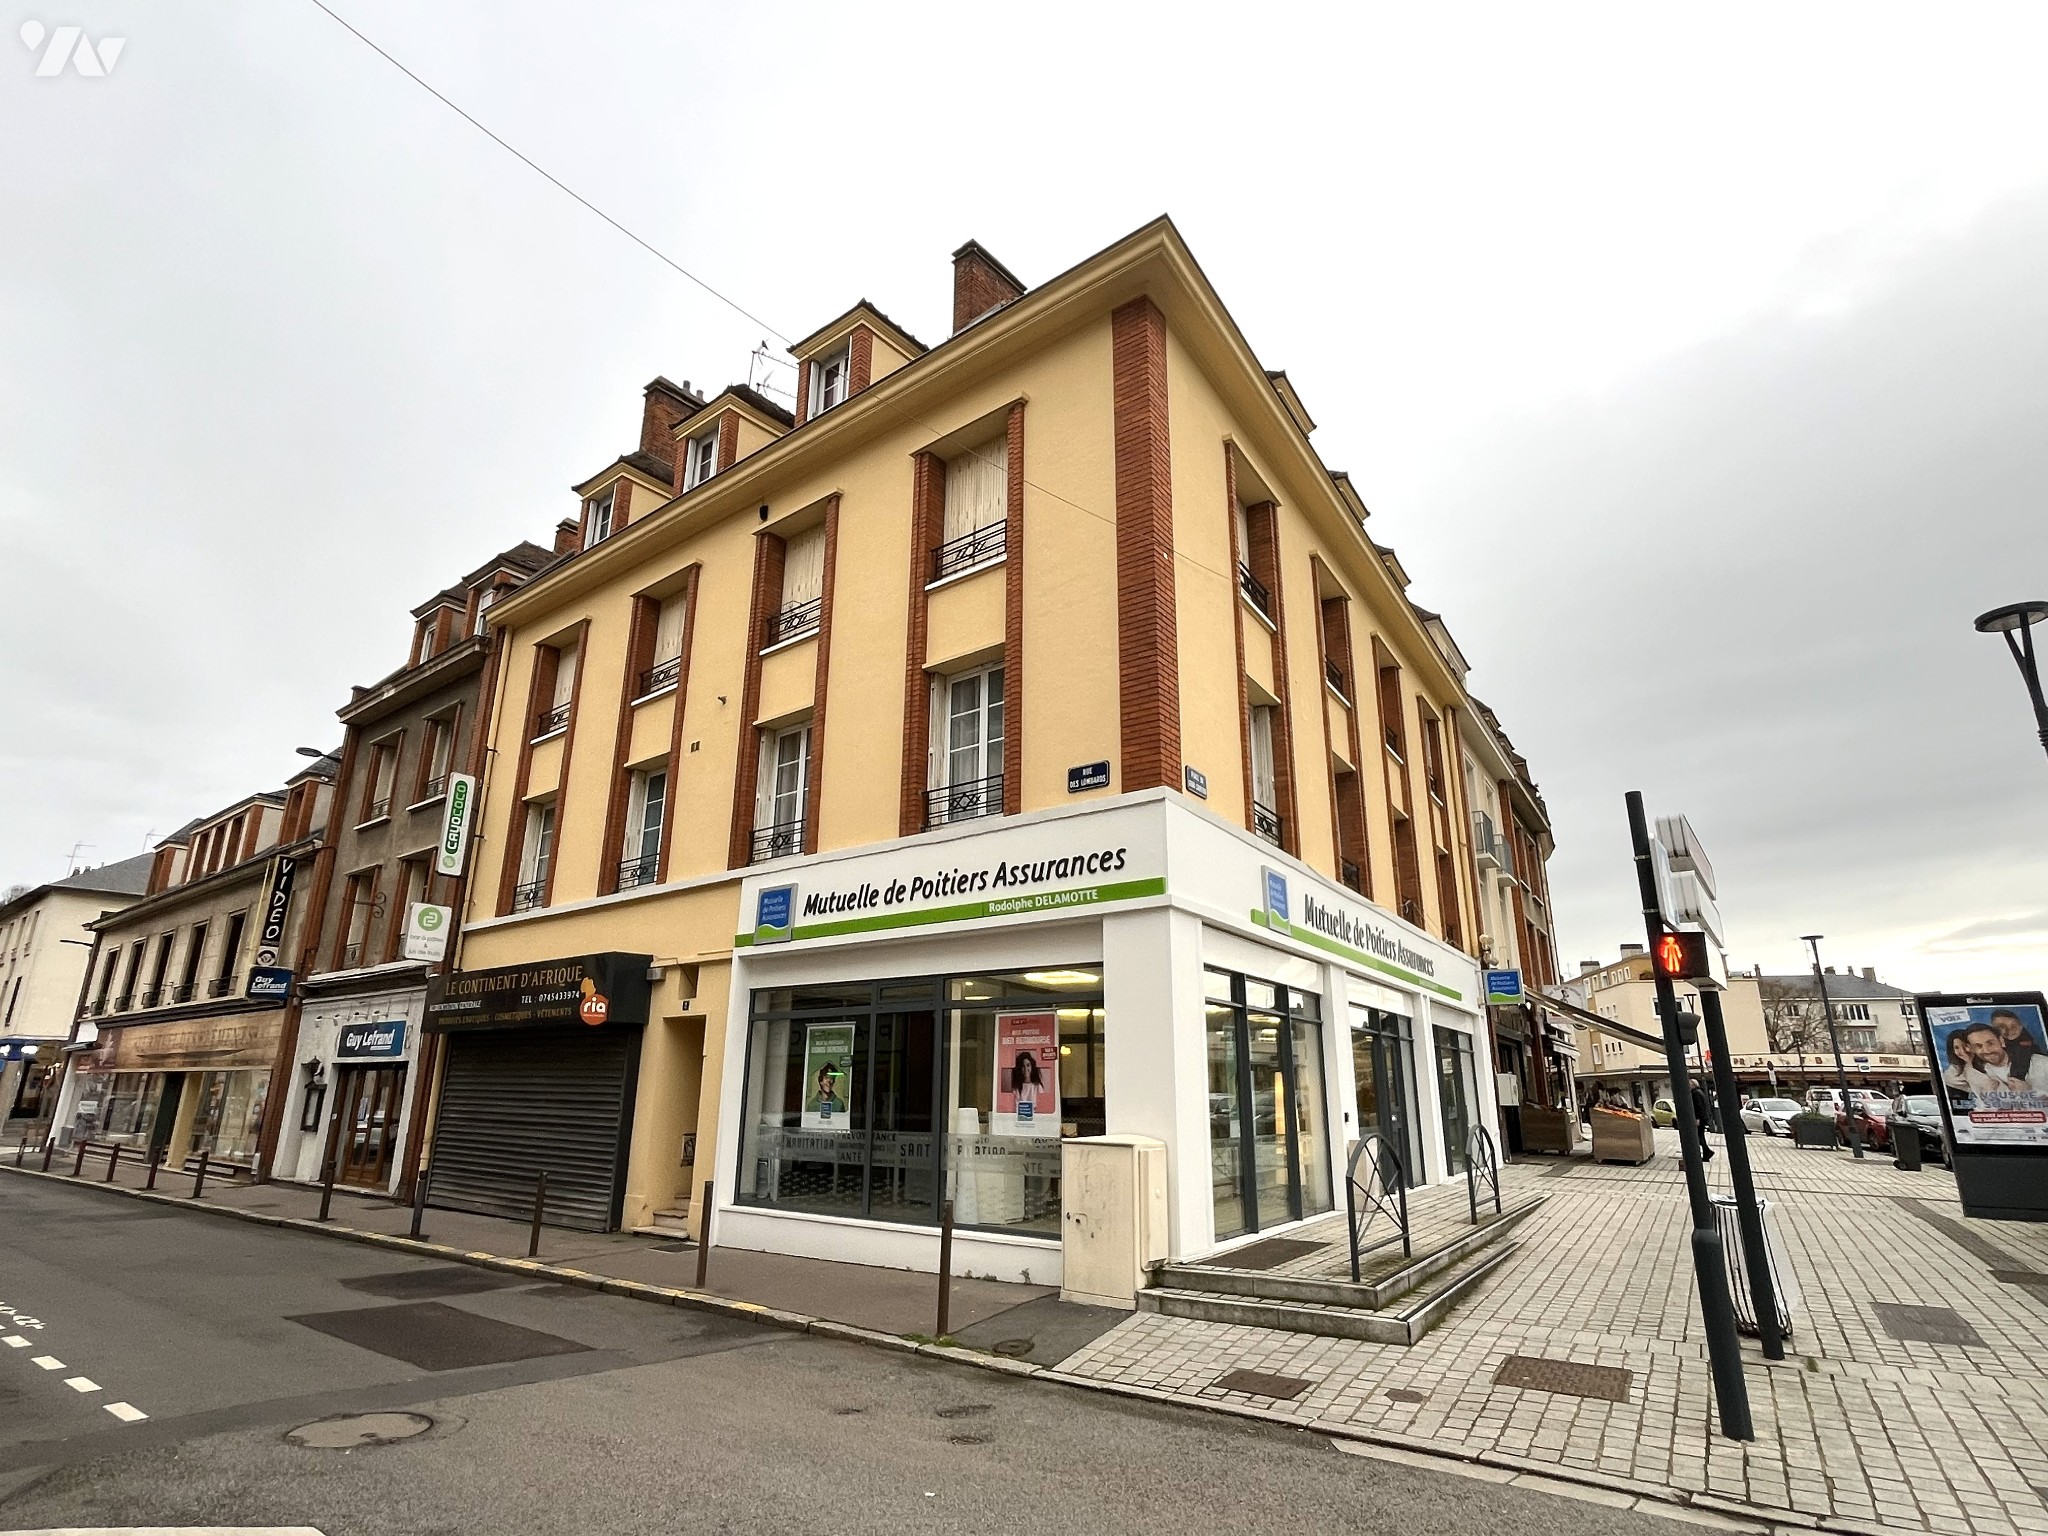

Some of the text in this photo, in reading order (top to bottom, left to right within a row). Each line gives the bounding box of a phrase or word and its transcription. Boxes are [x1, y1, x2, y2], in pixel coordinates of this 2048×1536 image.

[1070, 780, 1079, 788] DES
[446, 784, 467, 850] CAYOCOCO
[803, 847, 1127, 917] Mutuelle de Poitiers Assurances
[266, 859, 293, 939] VIDEO
[988, 888, 1099, 913] Rodolphe DELAMOTTE
[1304, 893, 1435, 978] Mutuelle de Poitiers Assurances
[251, 982, 288, 990] Lefrand
[255, 975, 275, 984] Guy
[445, 965, 583, 996] LE CONTINENT D'AFRIQUE
[521, 995, 532, 1004] TEL
[583, 996, 606, 1013] ria
[346, 1028, 396, 1050] Guy Lefrand
